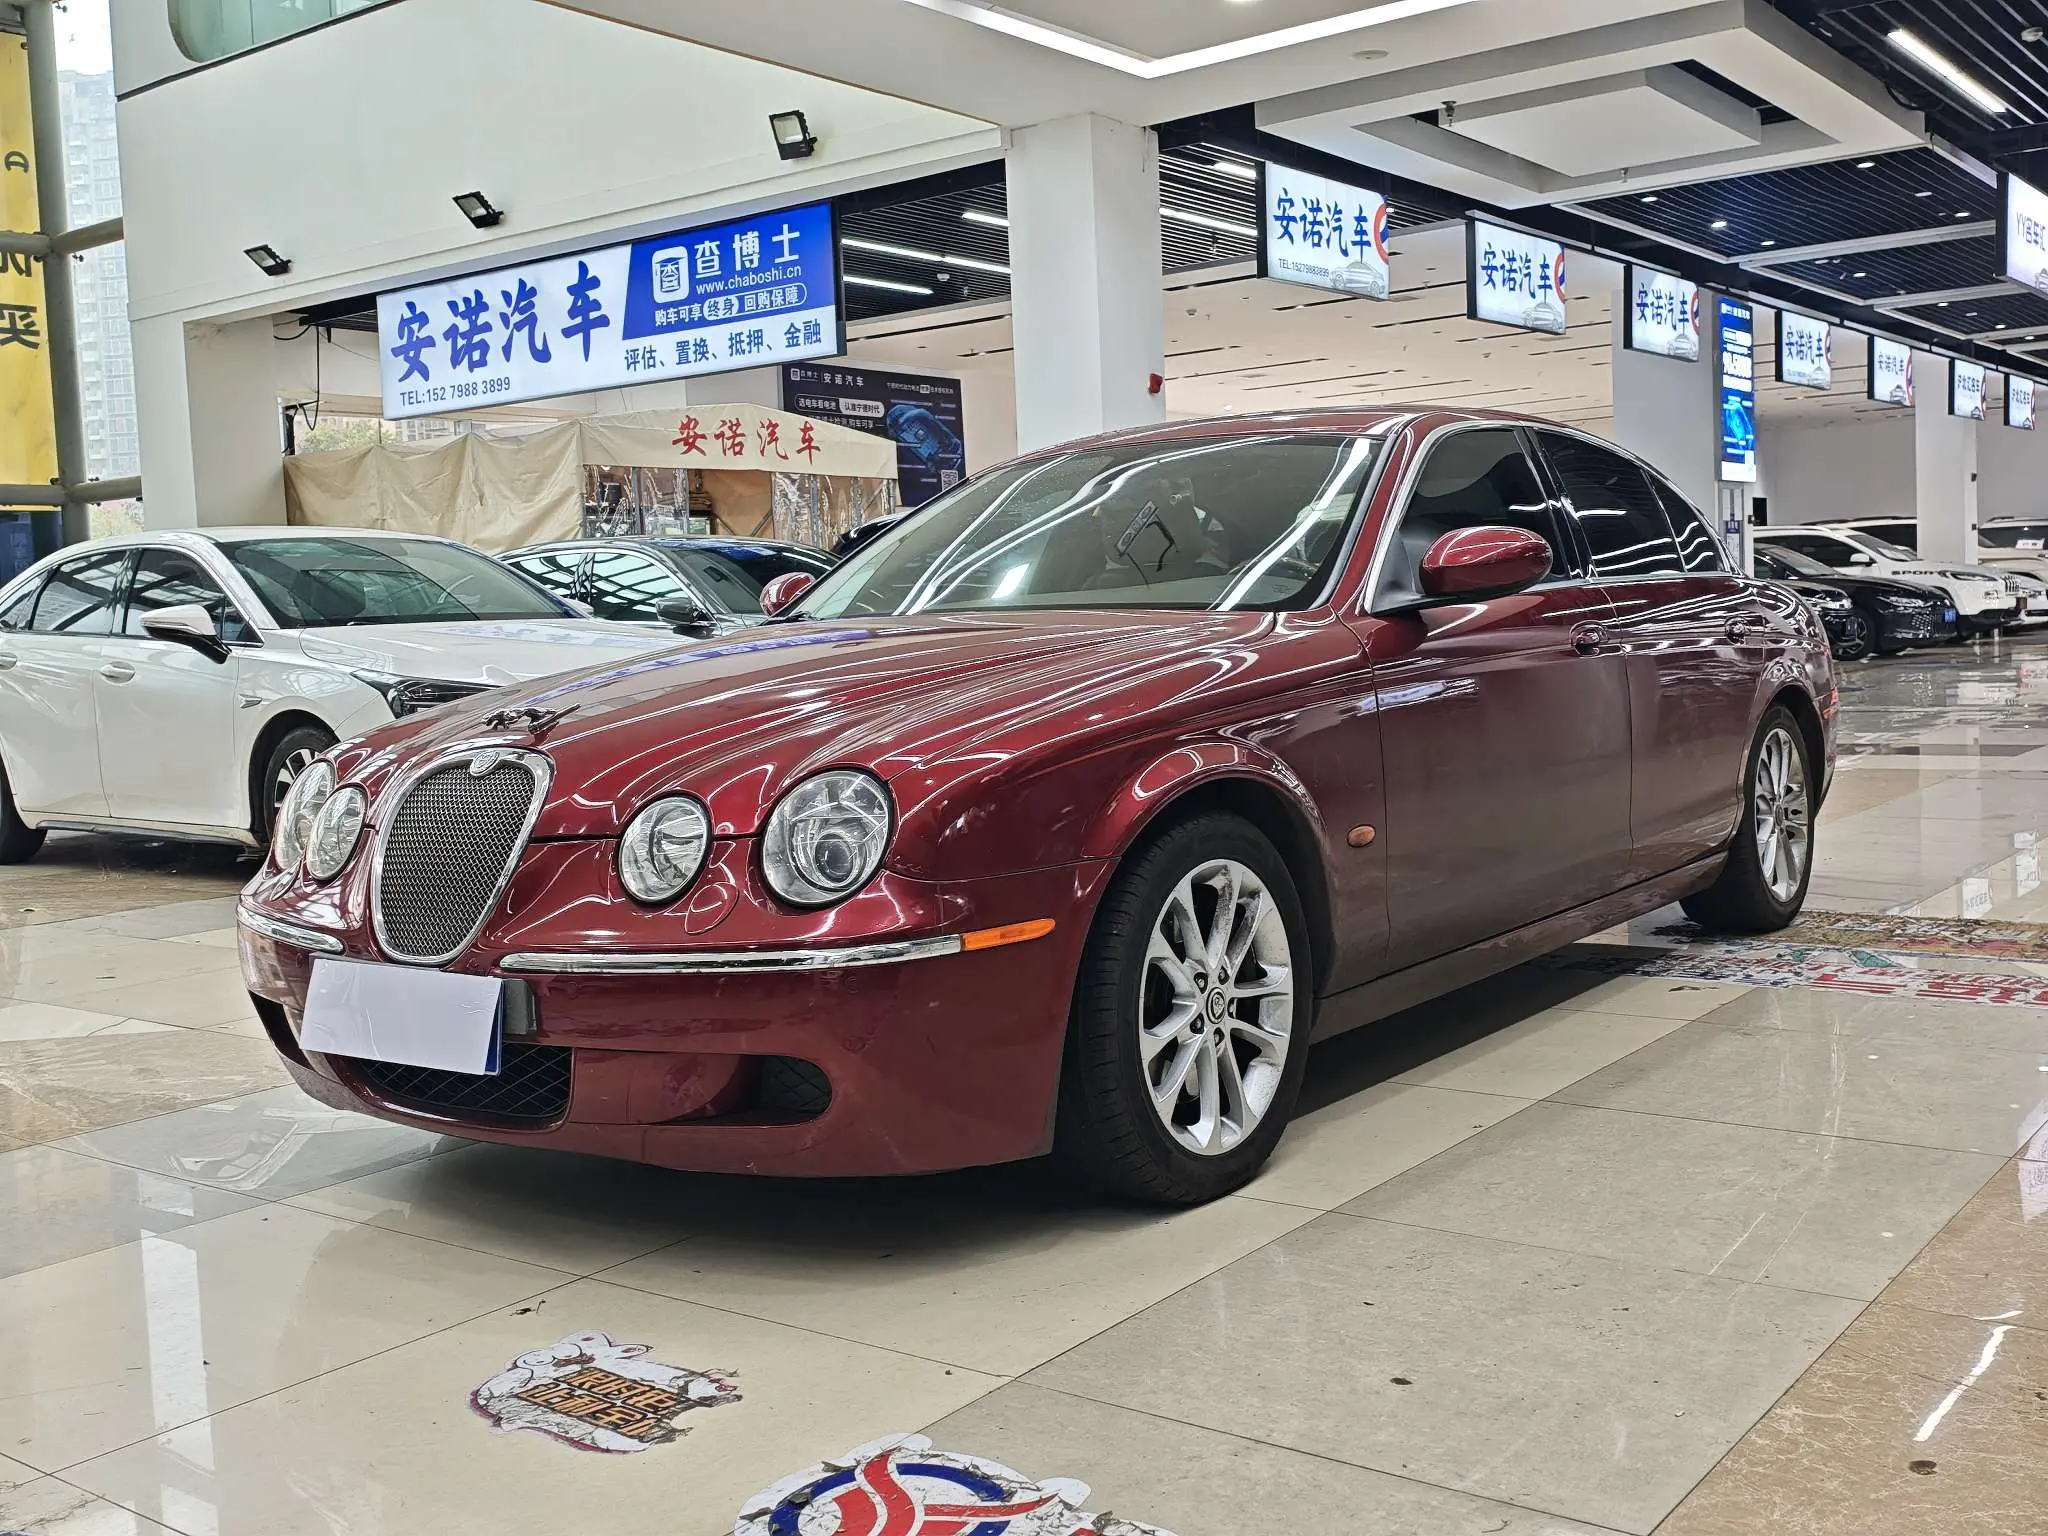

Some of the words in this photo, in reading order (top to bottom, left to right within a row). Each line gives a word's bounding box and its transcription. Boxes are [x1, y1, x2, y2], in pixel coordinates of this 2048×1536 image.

[694, 224, 800, 278] 查博士
[1273, 187, 1371, 264] 安诺汽车
[696, 265, 802, 295] www.chaboshi.cn
[1480, 241, 1553, 304] 安诺汽车
[391, 260, 610, 382] 安诺汽车
[655, 302, 704, 326] 购车可享
[707, 297, 735, 318] 终身
[744, 285, 799, 311] 回购保障
[1636, 282, 1689, 336] 安诺汽车
[1785, 325, 1824, 367] 安诺汽车
[400, 386, 446, 406] TEL:152
[450, 382, 478, 400] 7988
[481, 376, 511, 394] 3899
[672, 415, 821, 465] 安诺汽车
